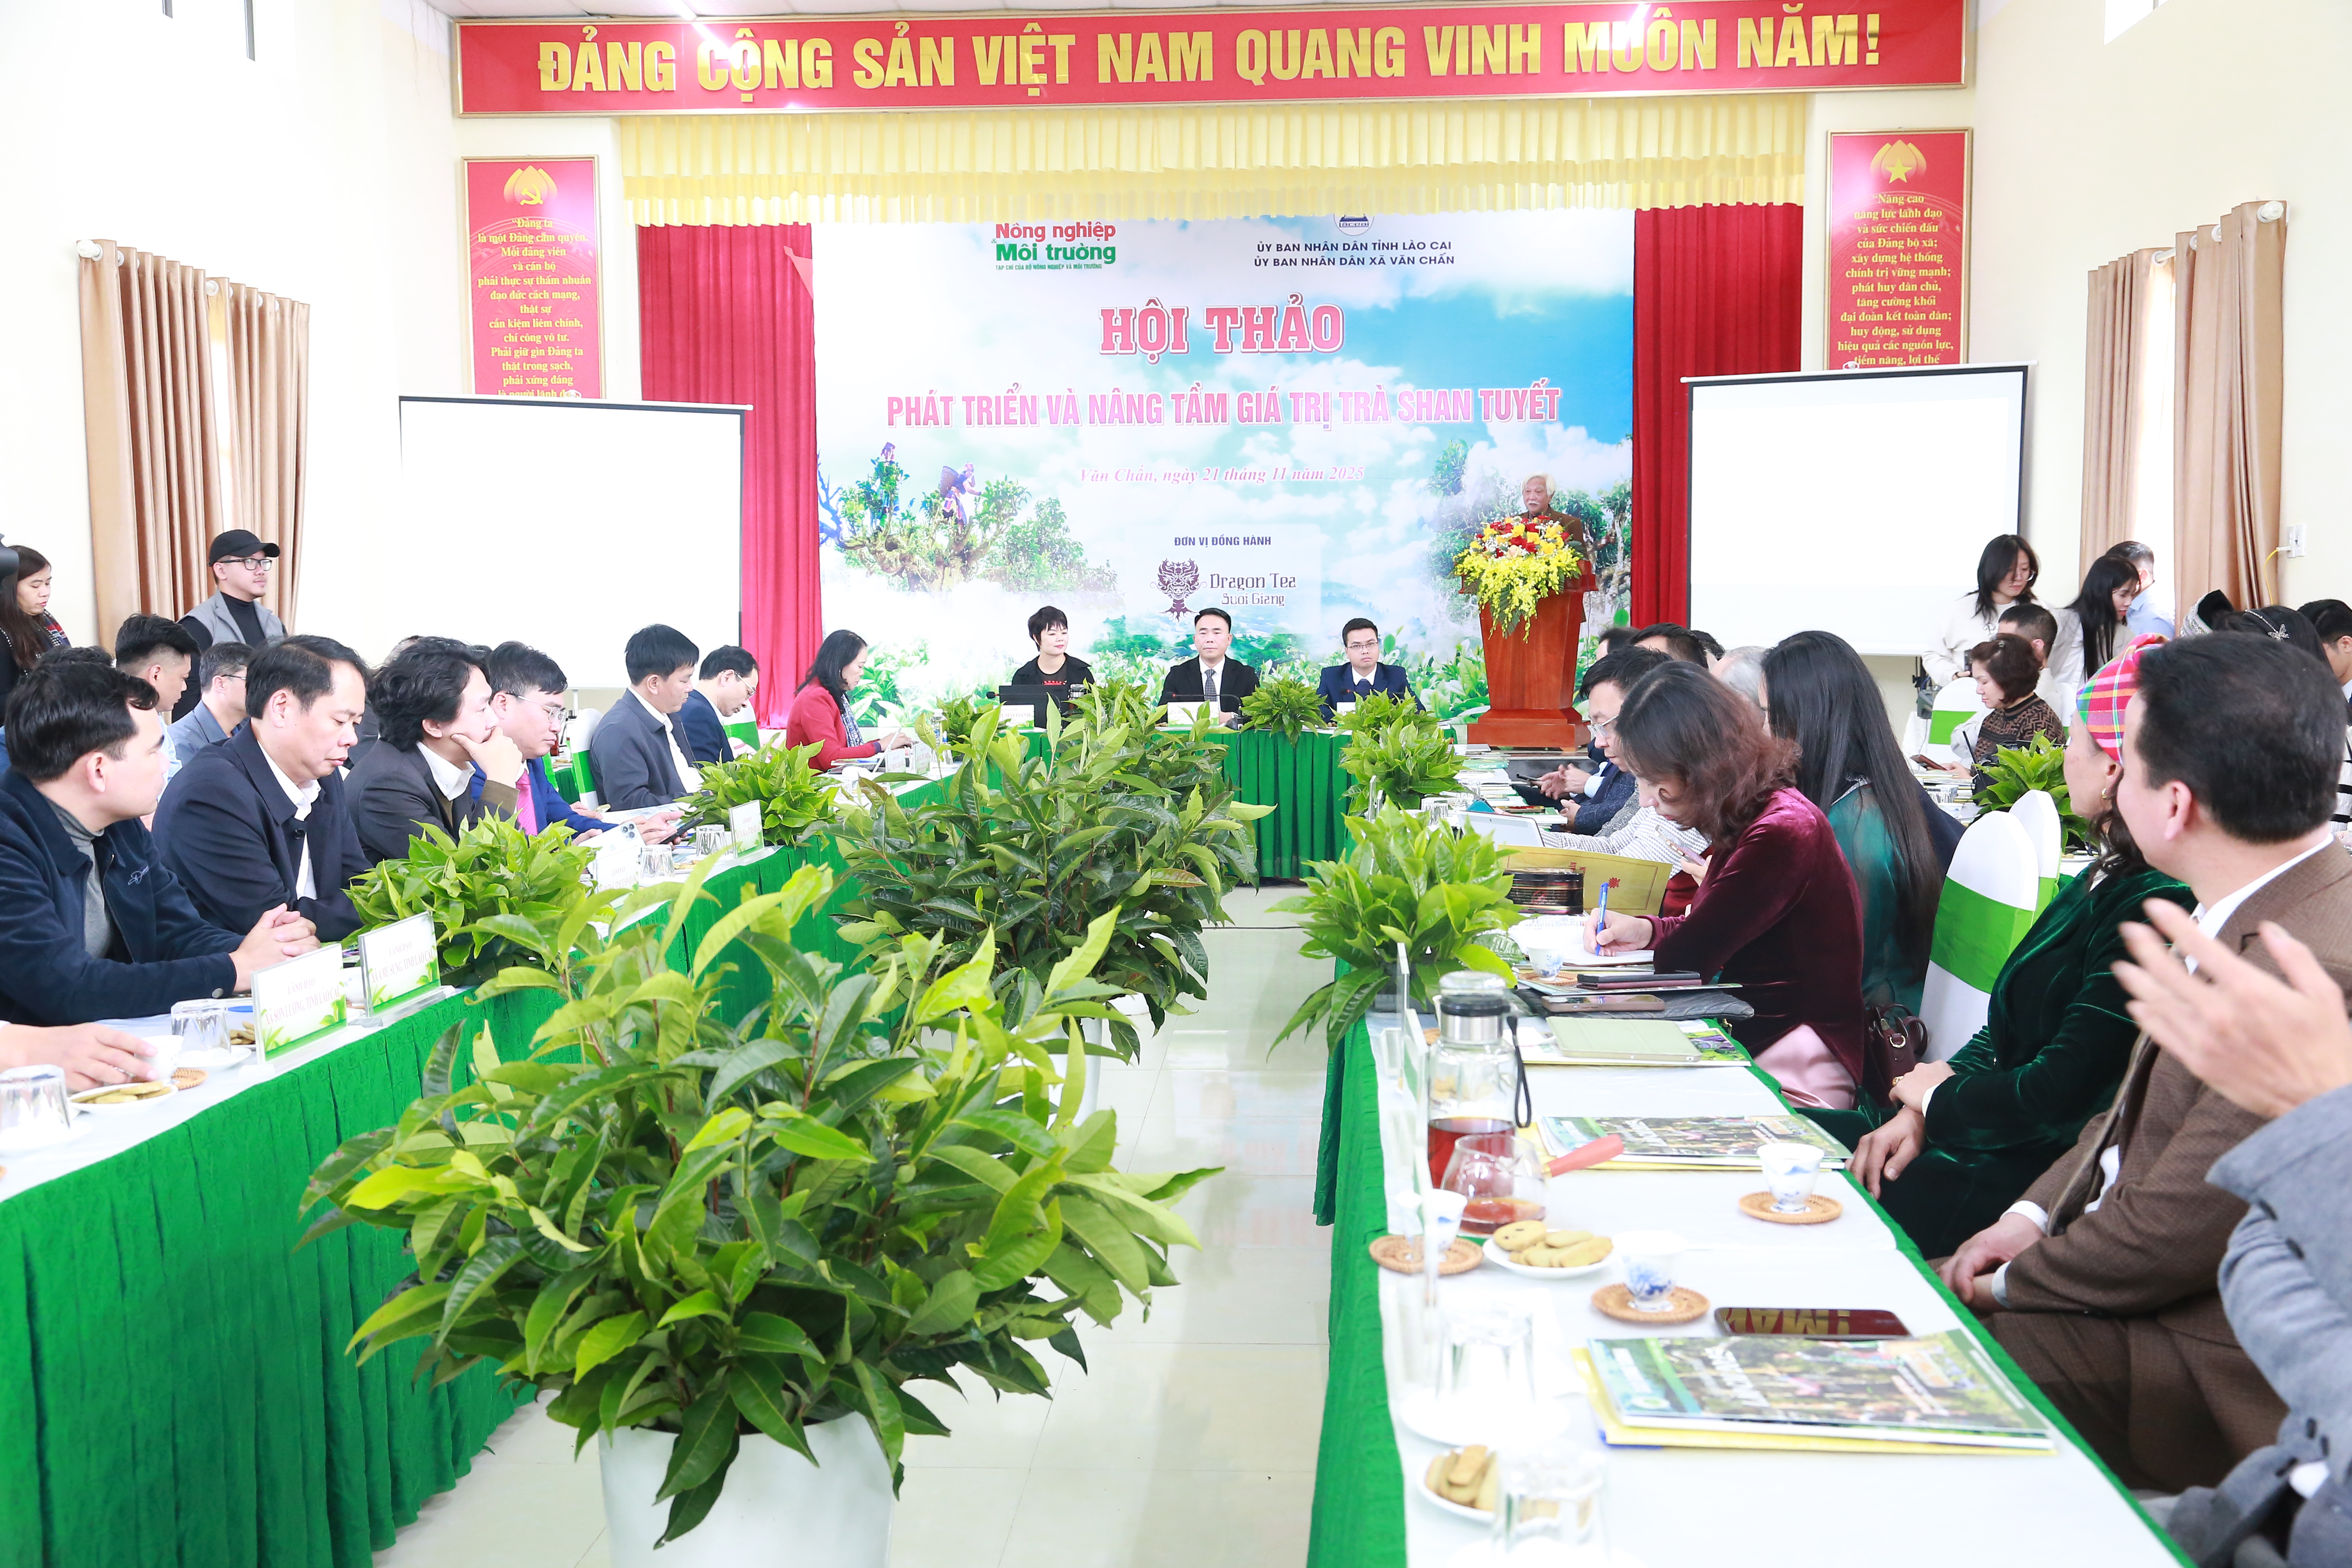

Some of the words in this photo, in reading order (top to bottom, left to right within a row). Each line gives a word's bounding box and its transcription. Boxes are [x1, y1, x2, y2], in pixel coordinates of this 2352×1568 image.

[538, 25, 675, 91] ĐẢNG
[697, 28, 833, 102] CỘNG
[853, 22, 955, 88] SẢN
[972, 22, 1076, 96] VIỆT
[1098, 31, 1214, 83] NAM
[1236, 26, 1406, 85] QUANG
[1423, 23, 1541, 75] VINH
[1564, 8, 1717, 73] MUÔN
[1737, 2, 1880, 67] NĂM!
[1881, 209, 1897, 219] lực
[1923, 208, 1943, 219] đạo
[512, 218, 542, 229] “Đảng
[1858, 225, 1869, 233] và
[1871, 224, 1889, 233] sức
[1890, 223, 1918, 233] chiến
[1919, 223, 1939, 233] đấu
[996, 223, 1045, 242] Nông
[1053, 221, 1116, 242] nghiệp
[477, 233, 487, 243] là
[488, 234, 507, 244] một
[509, 232, 534, 244] Đảng
[1857, 238, 1875, 248] của
[1877, 238, 1905, 249] Đảng
[1906, 238, 1920, 248] bộ
[501, 246, 520, 256] Mỗi
[521, 247, 545, 258] đảng
[547, 247, 566, 256] viên
[1257, 241, 1272, 252] ỦY
[1276, 243, 1300, 252] BAN
[1305, 241, 1338, 252] NHÂN
[1343, 241, 1368, 251] DÂN
[1372, 240, 1398, 250] TỈNH
[1403, 241, 1426, 250] LÀO
[996, 243, 1038, 261] Môi
[1046, 243, 1116, 264] trường
[1852, 254, 1869, 265] xây
[1871, 253, 1898, 265] dựng
[1900, 253, 1913, 263] hệ
[1913, 252, 1944, 264] thống
[1254, 256, 1269, 267] ỦY
[1273, 258, 1297, 266] BAN
[1302, 255, 1335, 266] NHÂN
[1340, 255, 1365, 265] DÂN
[1370, 256, 1385, 265] XÃ
[1390, 255, 1414, 265] VĂN
[1419, 253, 1454, 264] CHẤN
[512, 262, 524, 270] và
[525, 262, 542, 270] cán
[544, 261, 556, 272] bộ
[1845, 268, 1875, 278] chính
[1876, 267, 1889, 278] trị
[1891, 267, 1917, 279] vững
[1918, 267, 1951, 277] mạnh;
[478, 276, 499, 287] phải
[500, 276, 521, 287] thực
[523, 278, 534, 286] sự
[535, 276, 560, 285] thấm
[562, 275, 591, 284] nhuần
[1852, 283, 1875, 294] phát
[1877, 282, 1896, 294] huy
[1898, 282, 1918, 291] dân
[1920, 281, 1942, 292] chủ,
[490, 291, 508, 300] đạo
[509, 290, 526, 299] đức
[528, 290, 550, 299] cách
[552, 292, 580, 301] mạng,
[1856, 298, 1880, 309] tăng
[1881, 297, 1911, 308] cường
[1913, 296, 1936, 306] khối
[520, 305, 539, 314] thật
[540, 305, 552, 314] sự
[1840, 312, 1857, 323] đại
[1858, 312, 1884, 321] đoàn
[1886, 312, 1902, 321] kết
[1904, 312, 1927, 321] toàn
[1929, 311, 1952, 321] dân;
[489, 318, 506, 328] cần
[508, 319, 530, 329] kiệm
[532, 318, 552, 327] liêm
[554, 318, 584, 327] chính,
[1100, 298, 1187, 361] HỘI
[1205, 294, 1342, 353] THẢO
[1850, 327, 1869, 338] huy
[1871, 326, 1900, 338] động,
[1902, 325, 1914, 335] sử
[1915, 325, 1942, 337] dụng
[503, 333, 518, 342] chí
[519, 334, 542, 344] công
[544, 333, 555, 341] vô
[1838, 341, 1859, 352] hiệu
[1861, 341, 1881, 352] quả
[1883, 341, 1900, 350] các
[1902, 340, 1933, 352] nguồn
[1936, 340, 1954, 350] lực,
[491, 347, 512, 356] Phải
[514, 347, 529, 358] giữ
[530, 347, 545, 358] gìn
[548, 347, 572, 358] Đảng
[502, 362, 521, 372] thật
[523, 363, 548, 372] trong
[550, 361, 573, 370] sạch,
[503, 375, 523, 387] phải
[526, 376, 548, 386] xứng
[550, 375, 573, 386] đáng
[887, 389, 954, 426] PHÁT
[961, 382, 1038, 425] TRIỂN
[1046, 388, 1080, 425] VÀ
[1089, 387, 1163, 425] NÂNG
[1170, 382, 1228, 423] TẦM
[1237, 385, 1281, 423] GIÁ
[1289, 391, 1330, 430] TRỊ
[1339, 384, 1389, 421] TRÀ
[1398, 390, 1471, 421] SHAN
[1479, 376, 1561, 423] TUYẾT
[1080, 469, 1109, 482] Văn
[1114, 465, 1157, 483] Chấn,
[1163, 468, 1198, 485] ngày
[1203, 468, 1219, 481] 21
[1224, 467, 1267, 484] tháng
[1272, 468, 1287, 480] 11
[1292, 468, 1324, 480] năm
[1329, 466, 1365, 480] 2025
[1174, 536, 1196, 546] ĐƠN
[1199, 537, 1208, 547] VỊ
[1211, 534, 1240, 546] ĐỒNG
[1243, 535, 1271, 546] HÀNH
[1210, 573, 1265, 591] Dragon
[1270, 573, 1296, 588] Tea
[1221, 592, 1249, 605] Suoi
[1252, 593, 1285, 607] Giang
